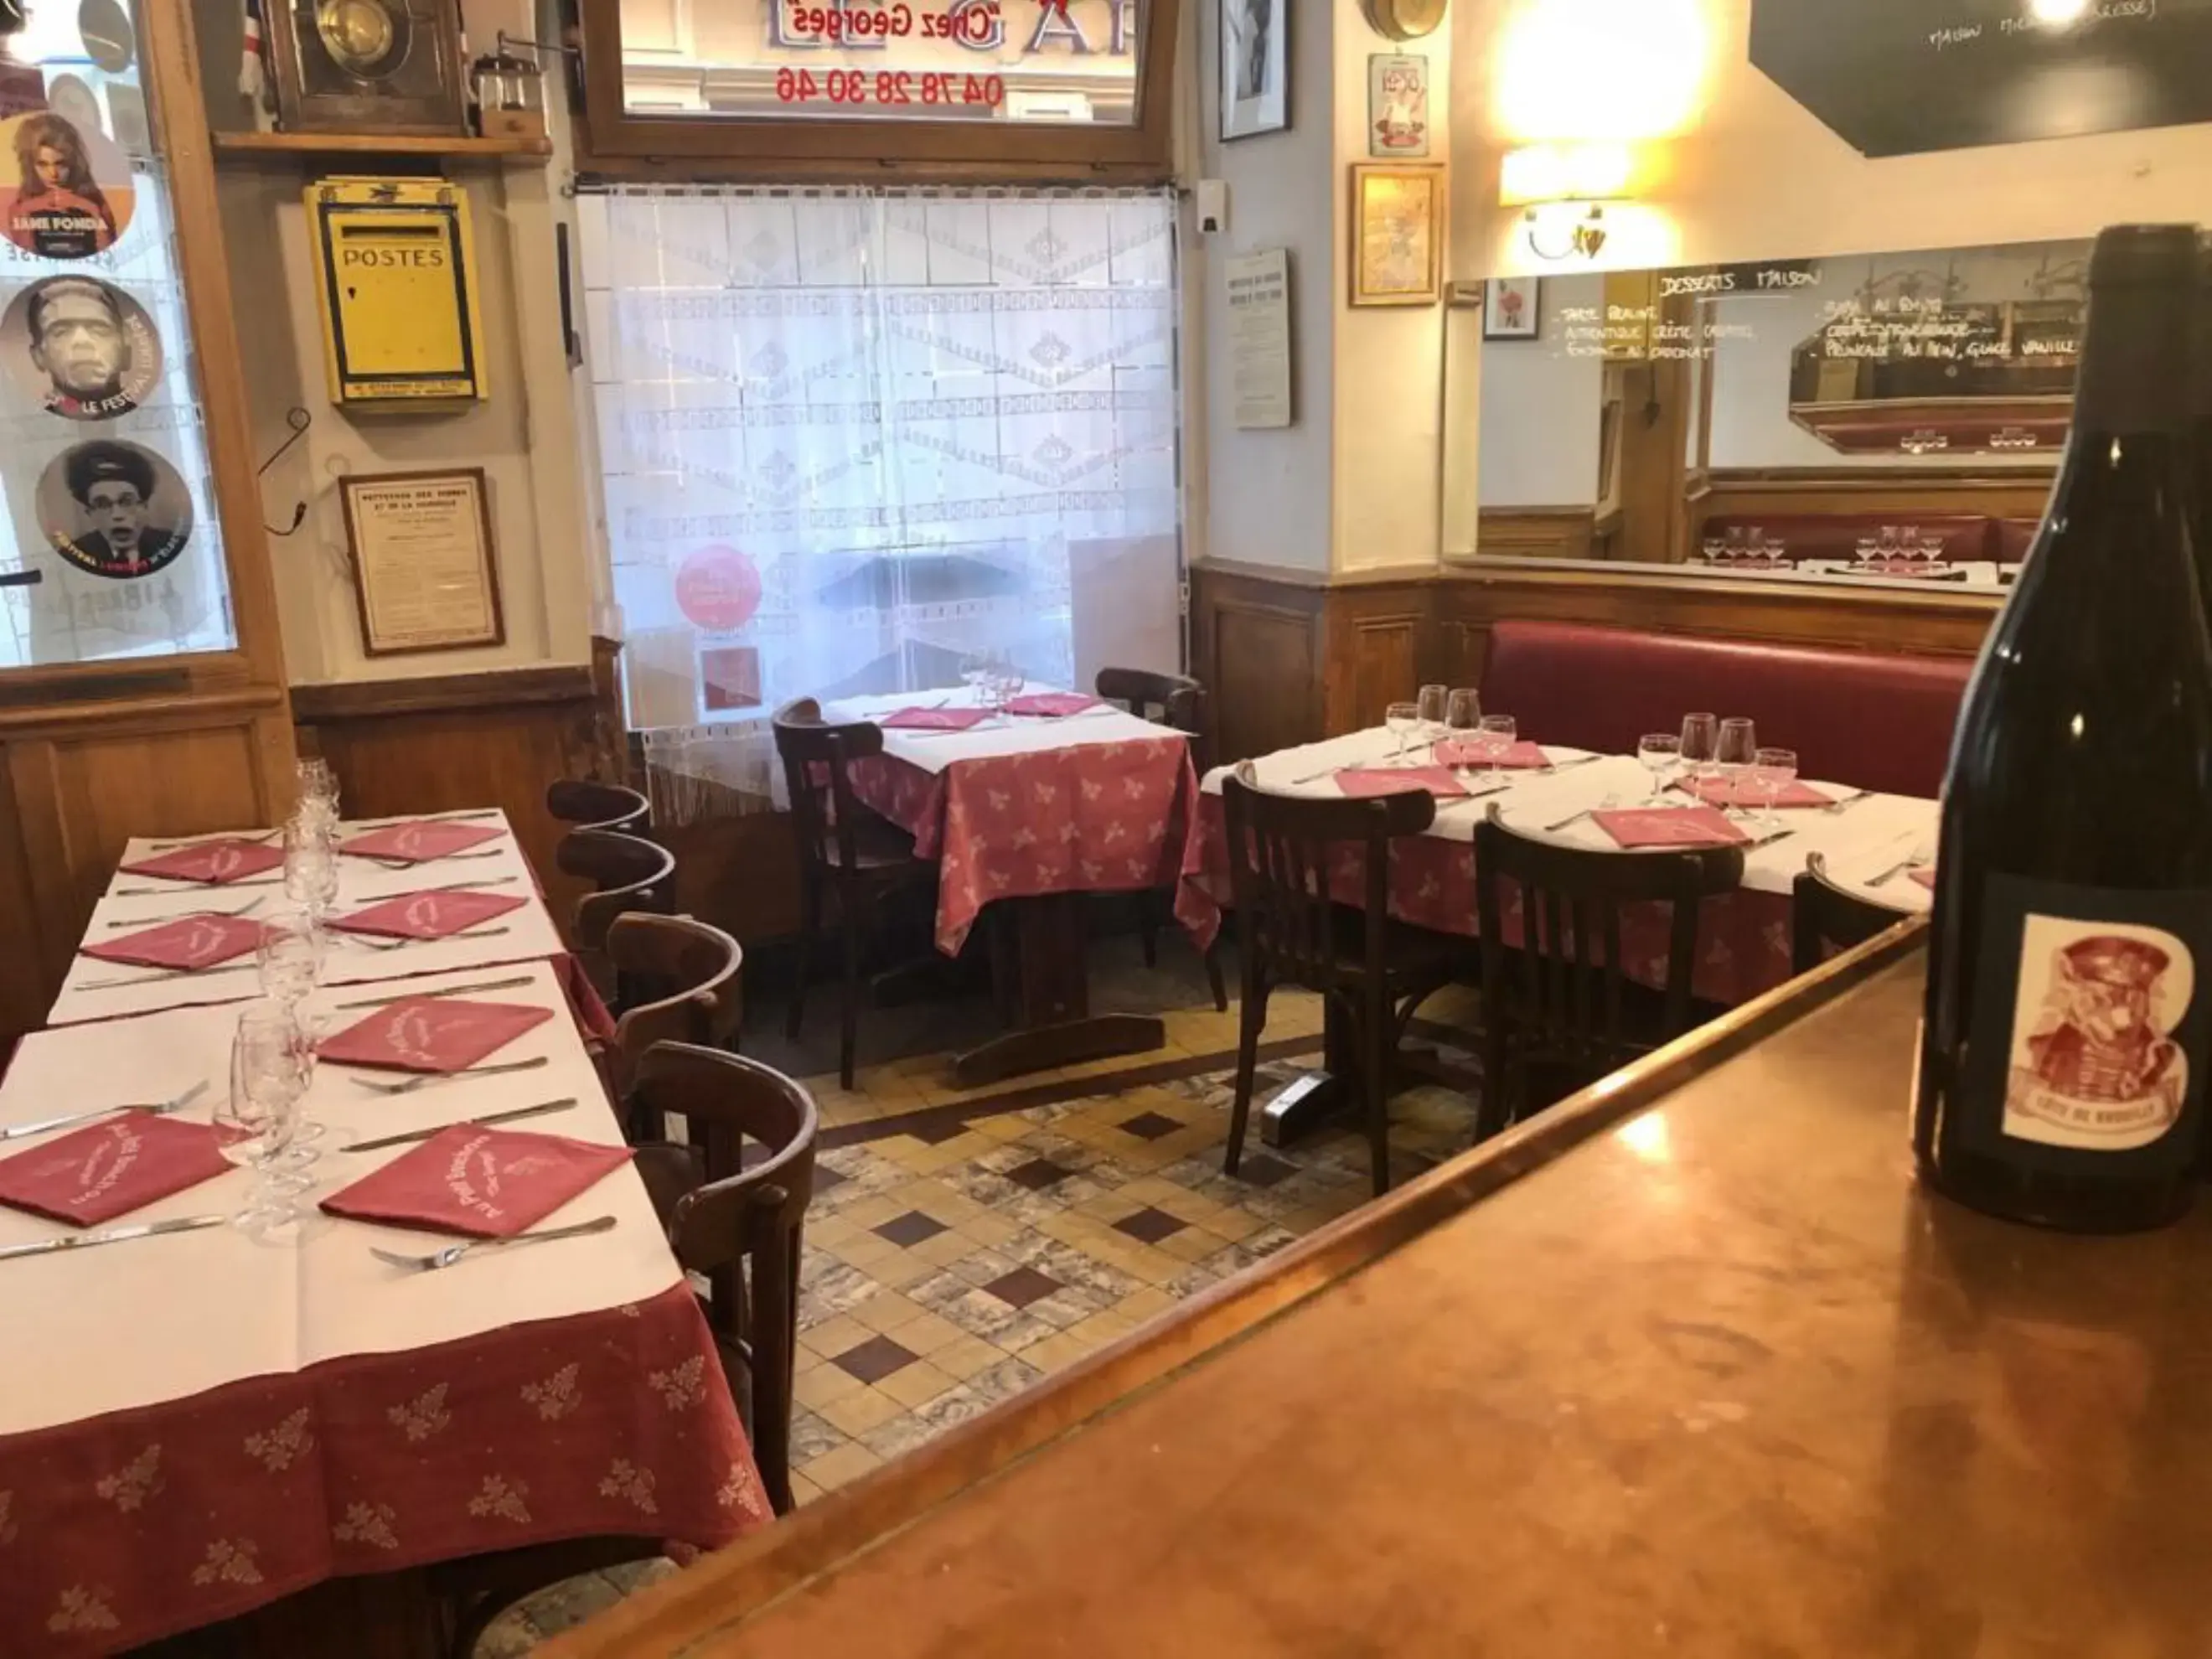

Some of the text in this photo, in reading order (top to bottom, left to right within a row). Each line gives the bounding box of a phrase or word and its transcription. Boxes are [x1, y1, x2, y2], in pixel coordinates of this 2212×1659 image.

[52, 216, 108, 230] FONDA
[344, 249, 444, 266] POSTES
[1659, 269, 1822, 297] DESSERTS MAISON
[82, 400, 98, 413] LE
